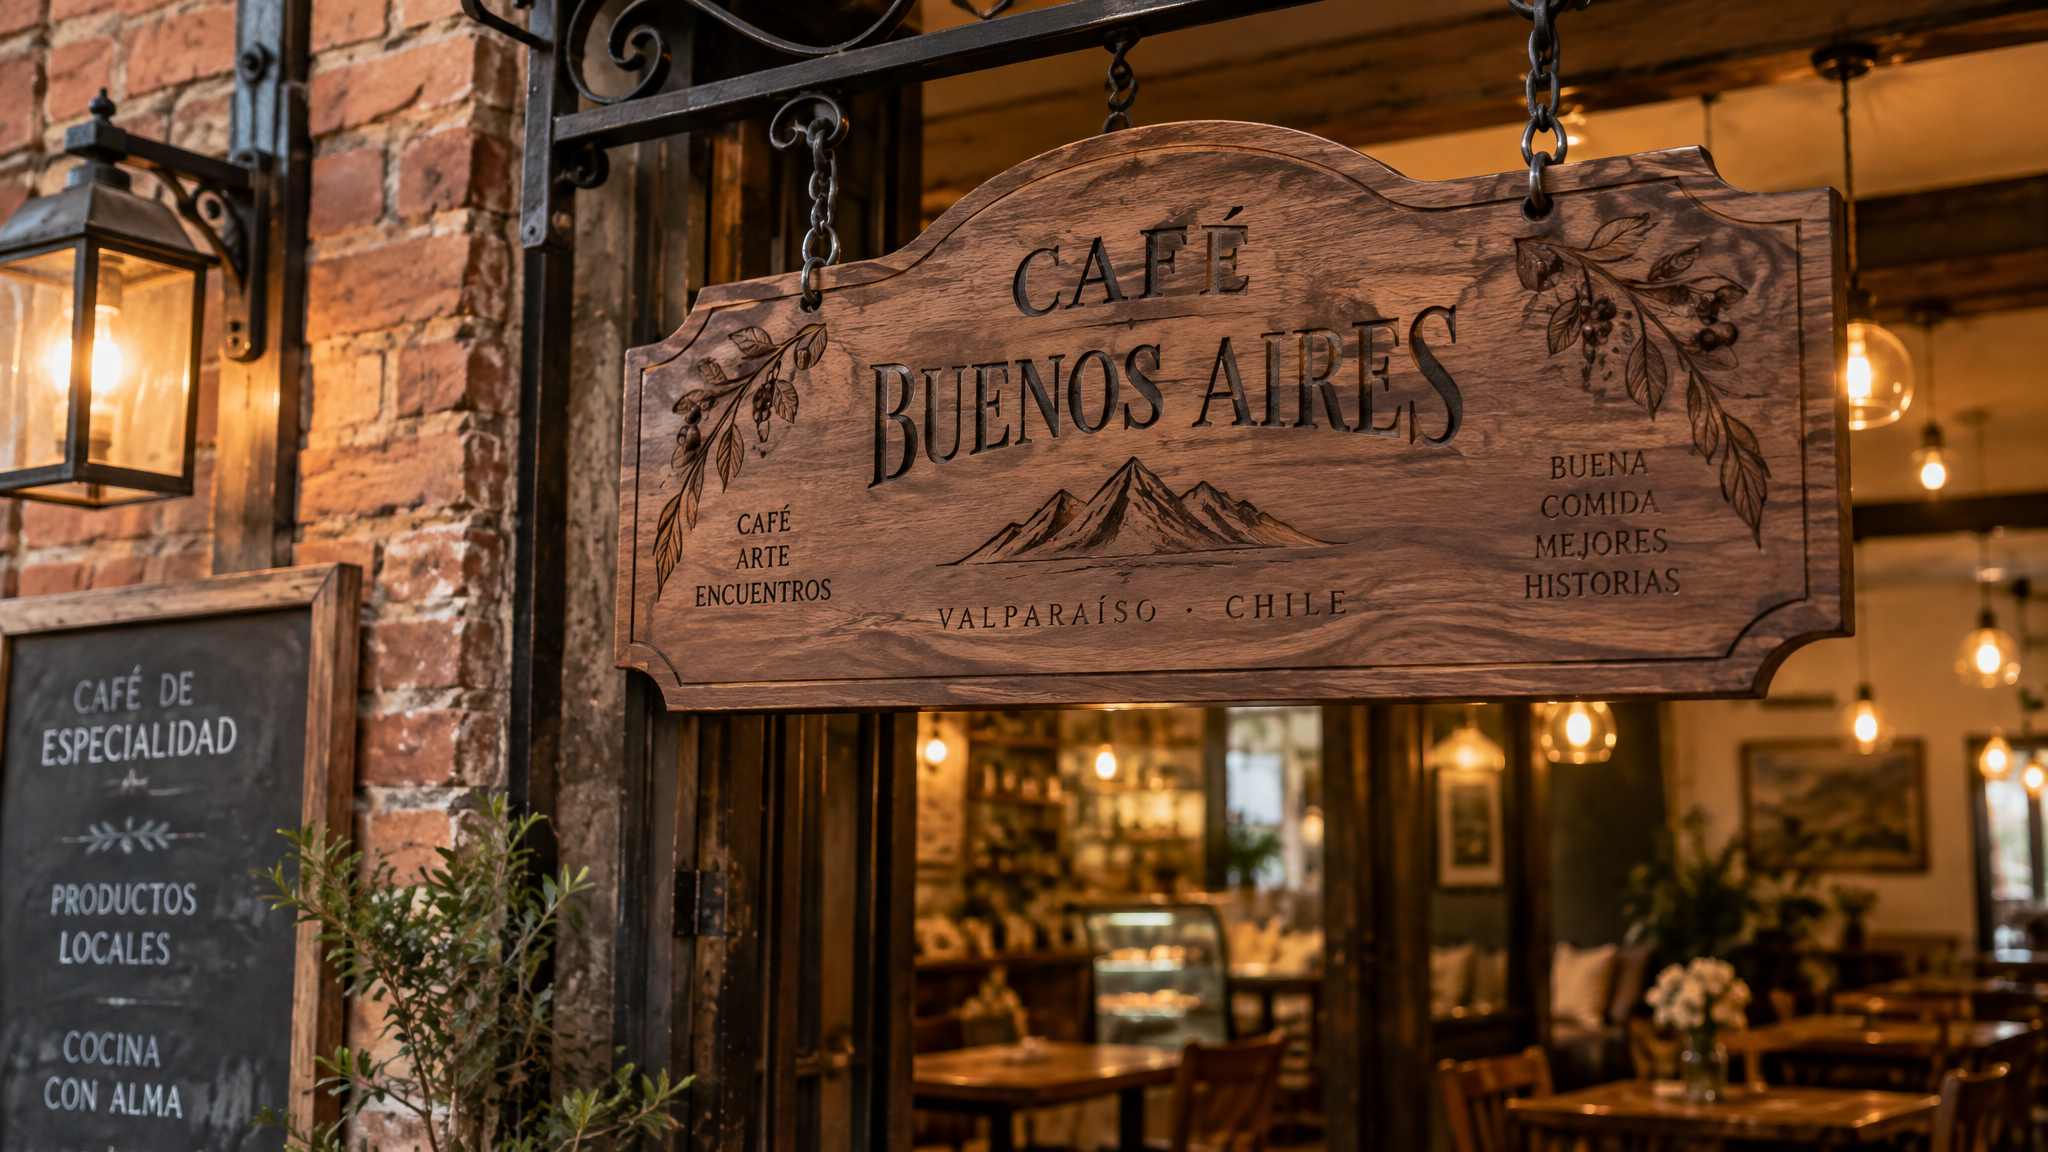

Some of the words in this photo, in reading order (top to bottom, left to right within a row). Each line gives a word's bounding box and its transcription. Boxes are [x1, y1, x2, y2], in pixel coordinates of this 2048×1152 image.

[1012, 205, 1250, 317] CAFÉ
[867, 344, 1164, 489] BUENOS
[1192, 304, 1463, 448] AIRES
[1550, 450, 1649, 479] BUENA
[737, 504, 791, 535] CAFÉ
[1541, 489, 1661, 519] COMIDA
[735, 545, 790, 570] ARTE
[1535, 528, 1668, 560] MEJORES
[695, 578, 831, 607] ENCUENTROS
[1525, 567, 1680, 599] HISTORIAS
[937, 595, 1157, 630] VALPARAÍSO
[1225, 590, 1347, 621] CHILE
[73, 664, 143, 714] CAFÉ
[159, 671, 195, 707] DE
[41, 716, 238, 766] ESPECIALIDAD
[50, 882, 197, 916] PRODUCTOS
[59, 931, 171, 965] LOCALES
[63, 1030, 161, 1068] COCINA
[44, 1076, 98, 1111] CON
[109, 1082, 183, 1119] ALMA
